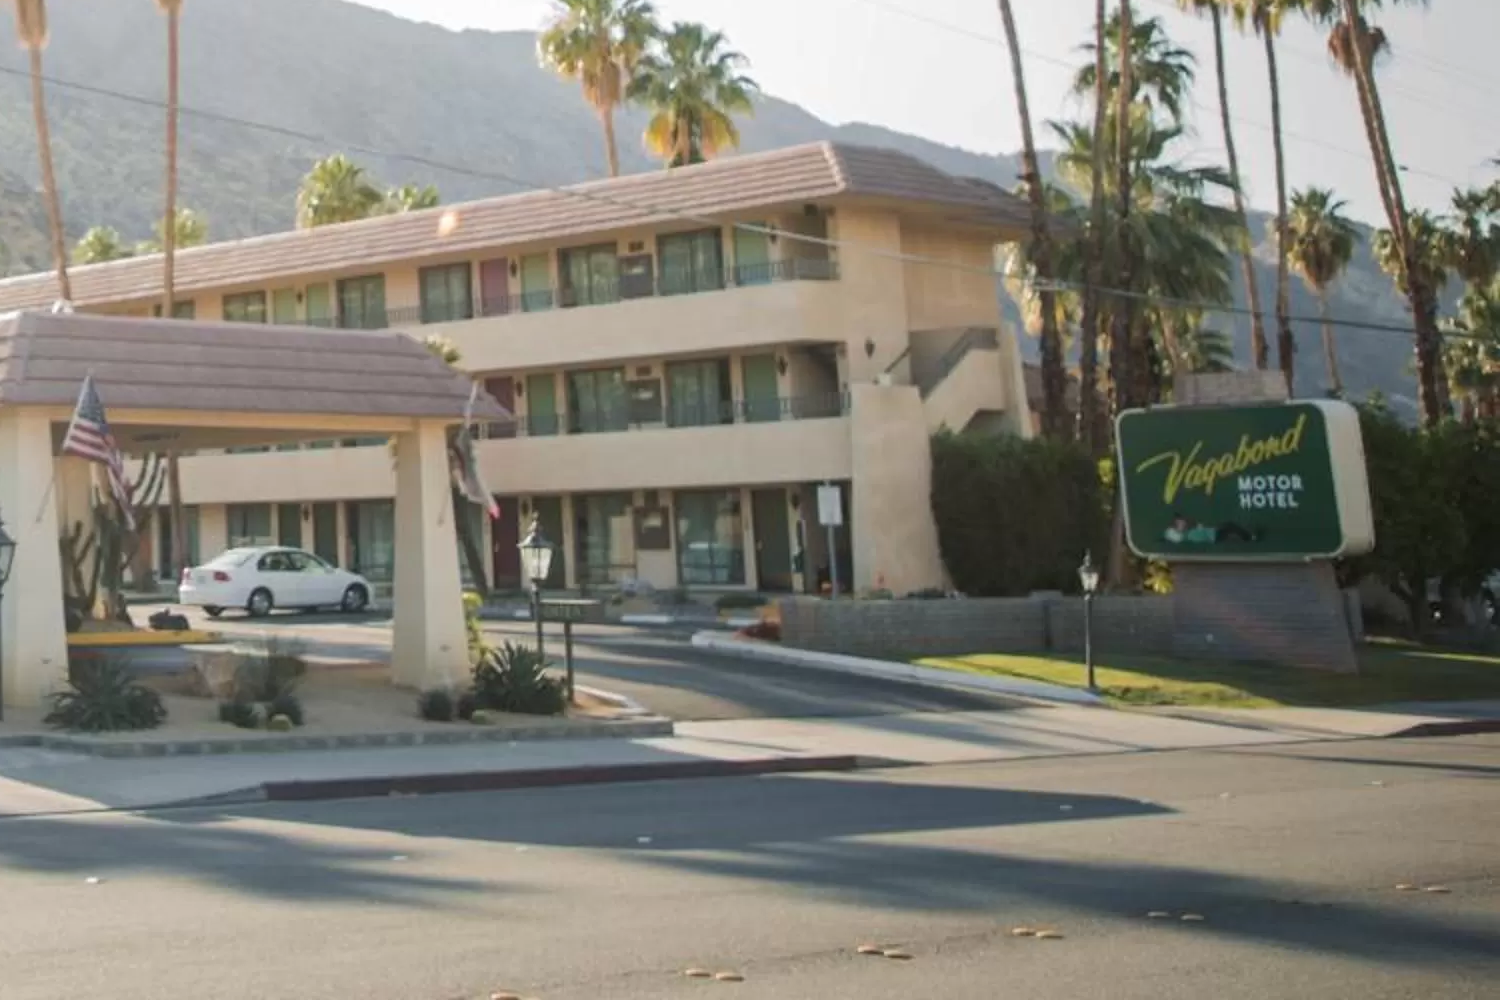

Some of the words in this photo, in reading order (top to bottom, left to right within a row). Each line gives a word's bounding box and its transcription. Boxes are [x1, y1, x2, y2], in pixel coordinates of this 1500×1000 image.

[1136, 413, 1306, 504] Vagabond
[1238, 474, 1303, 491] MOTOR
[1240, 492, 1299, 508] HOTEL
